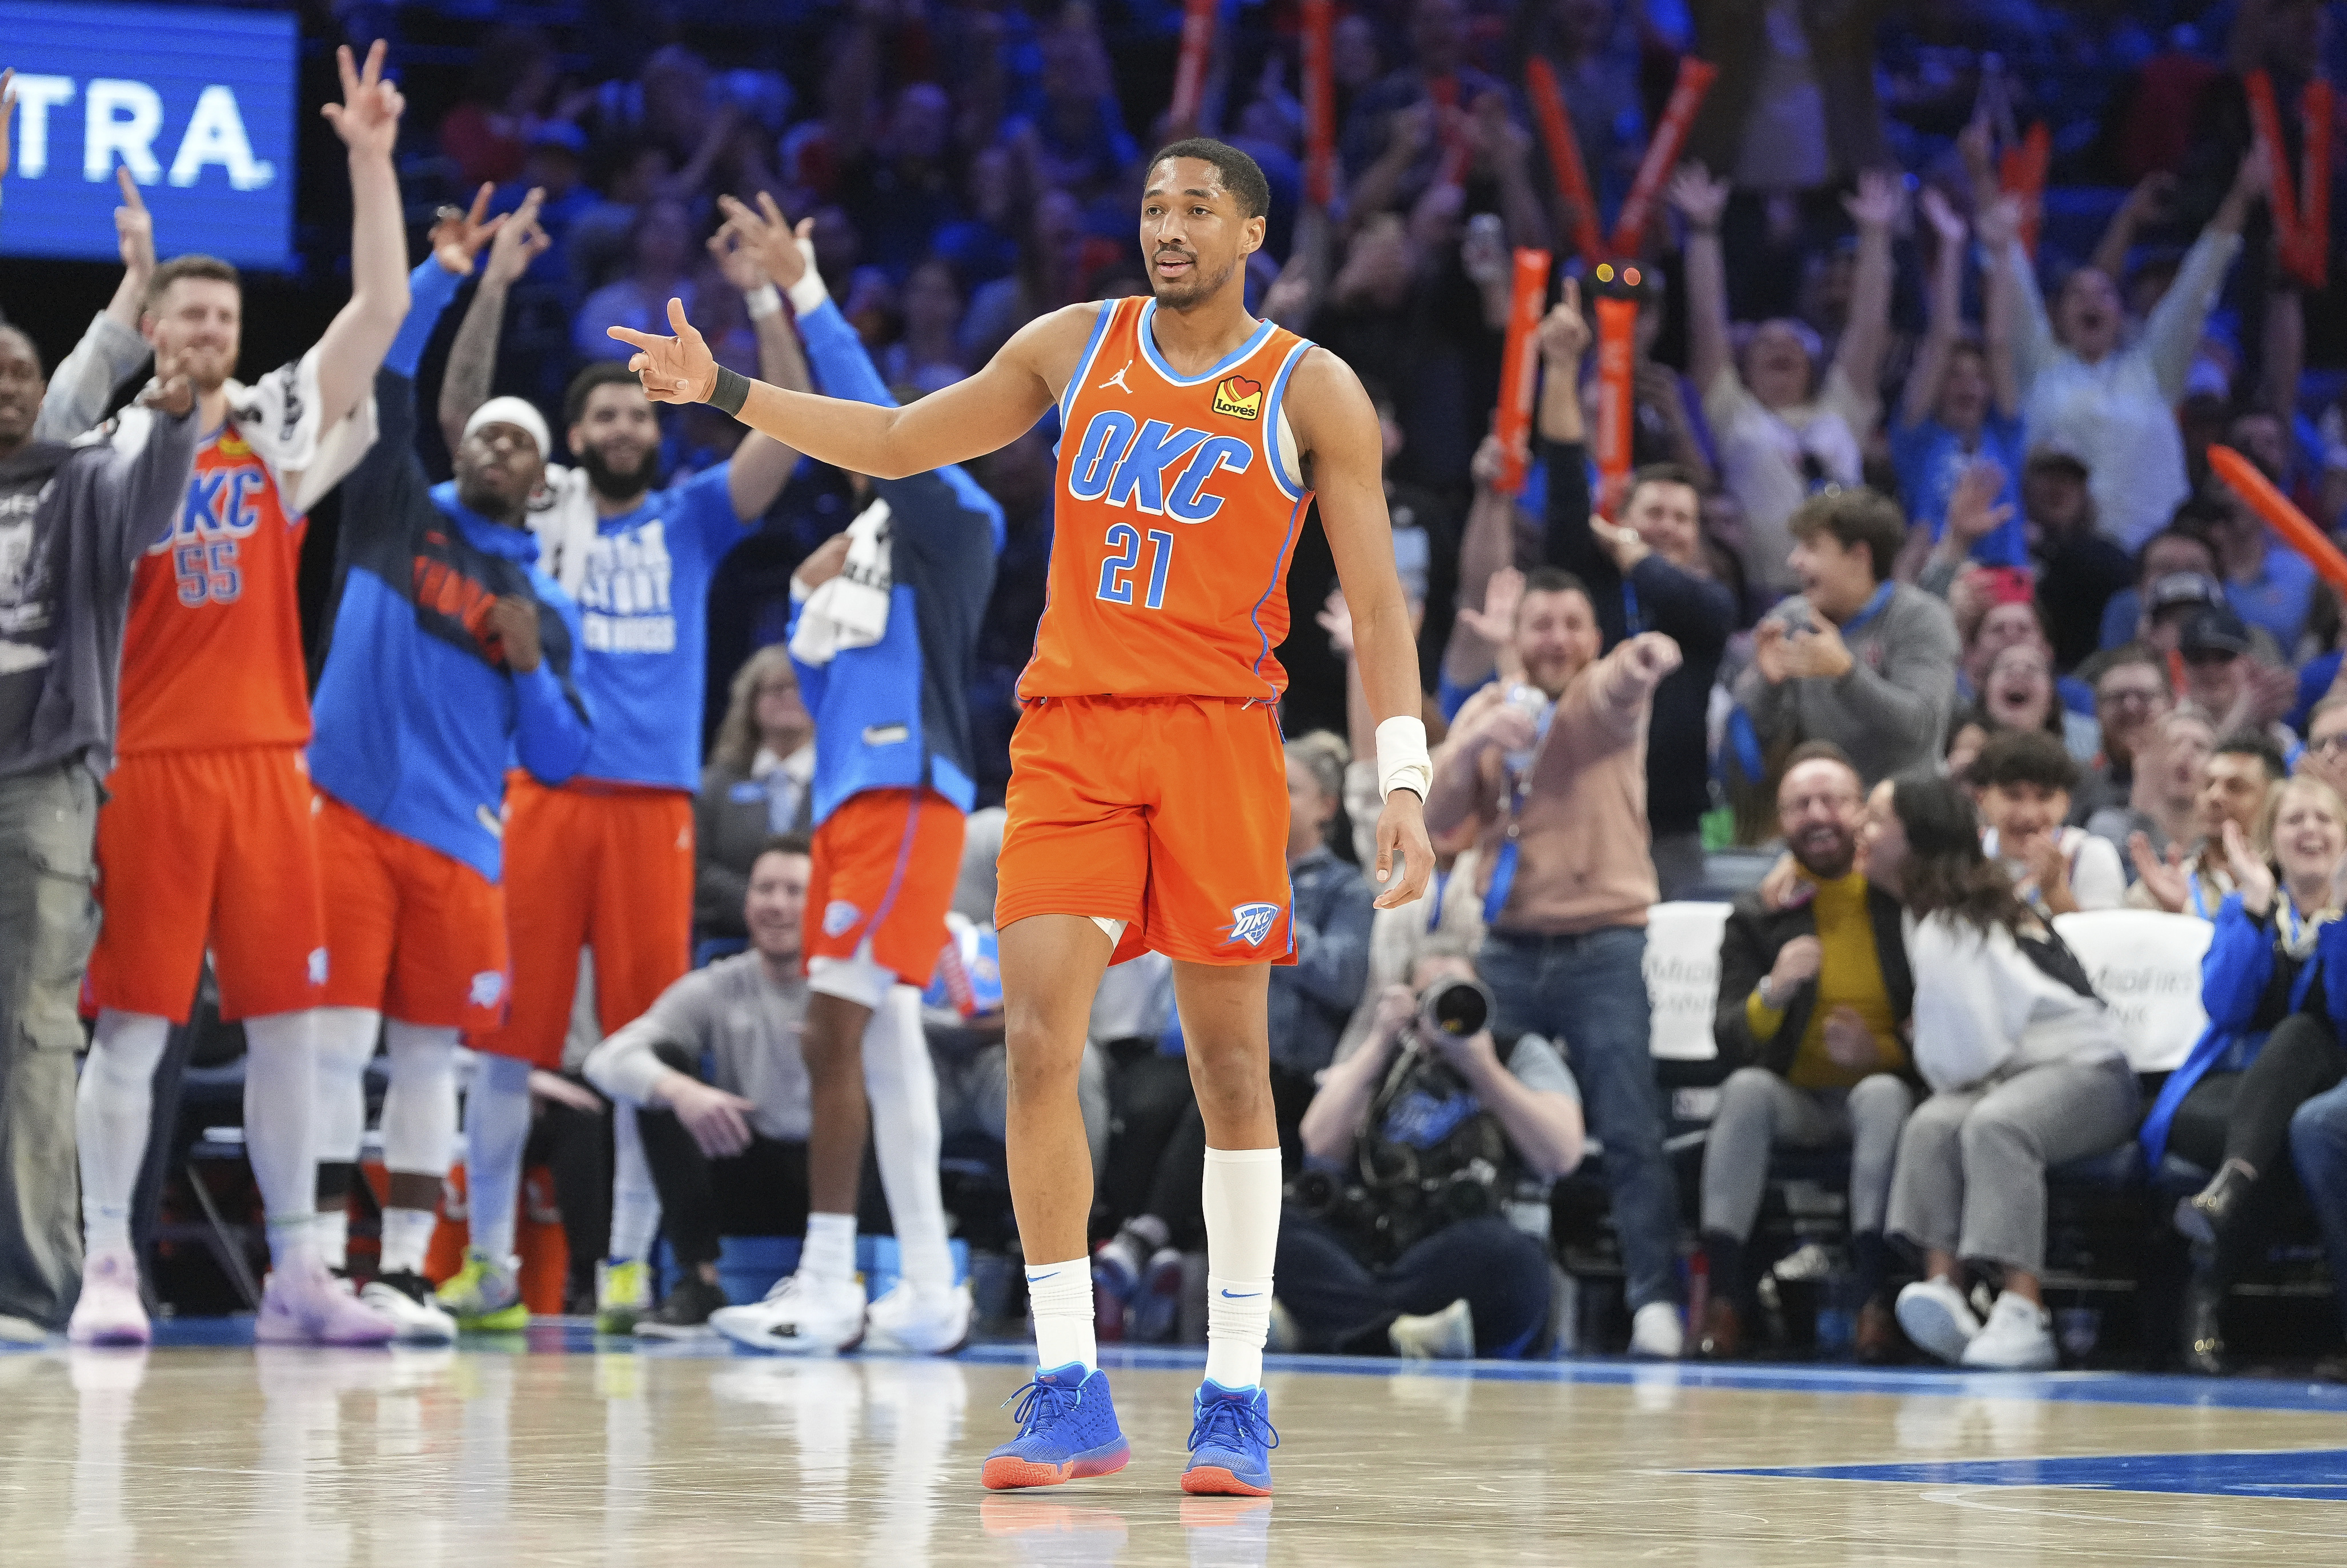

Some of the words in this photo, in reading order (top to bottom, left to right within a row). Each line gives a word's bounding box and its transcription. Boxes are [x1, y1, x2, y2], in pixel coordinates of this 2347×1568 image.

[147, 467, 266, 555] KC
[1068, 410, 1254, 525] OKC
[173, 542, 243, 608] 55
[1096, 522, 1174, 609] 21
[1230, 910, 1271, 937] OKC
